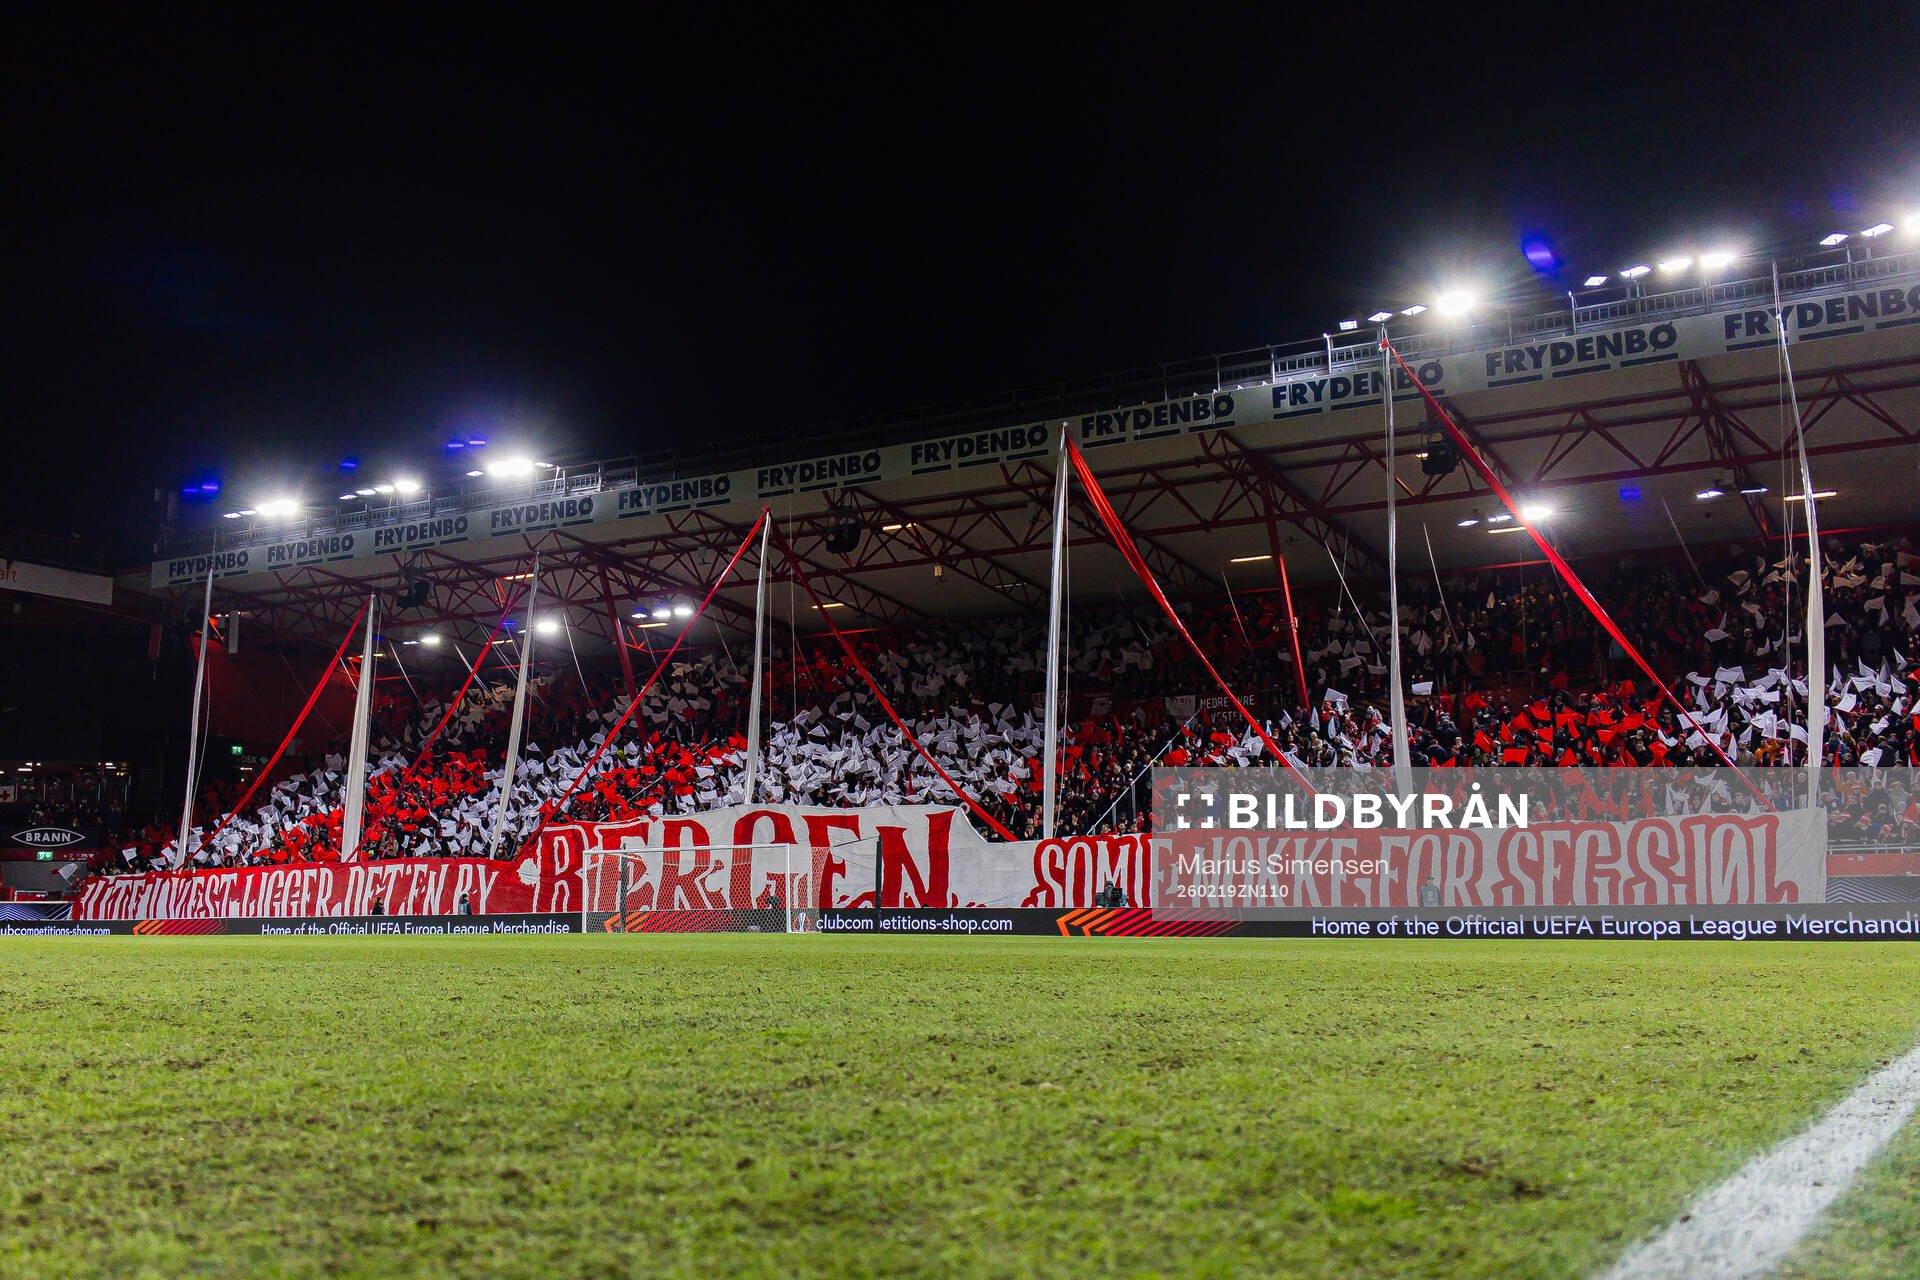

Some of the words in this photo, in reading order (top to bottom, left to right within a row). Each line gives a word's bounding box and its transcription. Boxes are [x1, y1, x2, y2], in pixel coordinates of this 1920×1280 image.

[1486, 321, 1677, 377] FRYDENBØ
[1082, 393, 1235, 438] FRYDENBØ
[912, 422, 1049, 465] FRYDENBØ
[758, 449, 881, 489] FRYDENBØ
[618, 473, 731, 510] FRYDENBØ
[491, 495, 594, 528] FRYDENBØ
[374, 514, 469, 547] FRYDENBØ
[168, 549, 249, 578] FRYDENBØ
[267, 533, 354, 563] FRYDENBØ
[26, 832, 71, 842] BRANN
[1379, 833, 1480, 907] FOR
[261, 924, 291, 935] Home
[294, 924, 307, 935] of
[308, 923, 326, 935] the
[329, 923, 365, 935] Official
[371, 923, 401, 935] UEFA
[405, 922, 444, 935] Europa
[447, 922, 490, 935] League
[493, 920, 570, 934] Merchandise
[1312, 916, 1370, 935] Home
[1376, 915, 1398, 935] of
[1405, 915, 1439, 935] the
[1446, 914, 1524, 935] Official
[1533, 915, 1594, 935] UEFA
[1601, 914, 1681, 940] Europa
[1690, 914, 1777, 941] League
